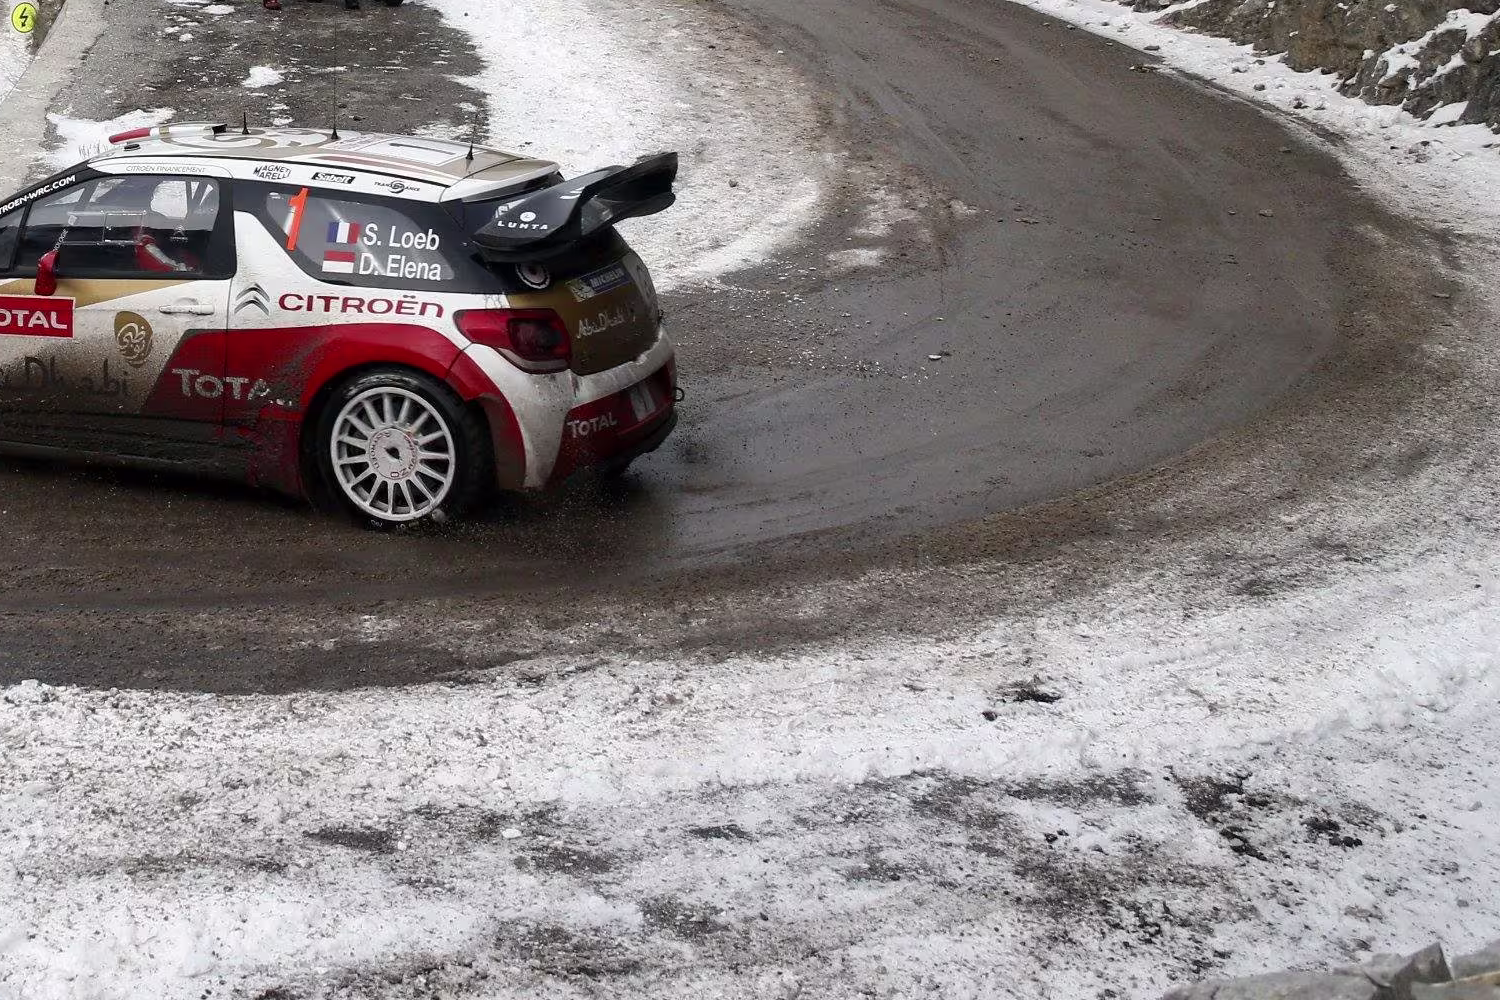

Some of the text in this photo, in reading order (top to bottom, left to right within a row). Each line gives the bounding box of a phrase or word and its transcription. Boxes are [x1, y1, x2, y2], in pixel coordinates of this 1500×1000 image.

[156, 166, 207, 174] FINANCEMENT
[314, 172, 353, 184] Sabelt
[286, 186, 309, 250] 1
[363, 223, 440, 250] S. Loeb
[359, 253, 442, 281] D. Elena
[278, 293, 444, 319] CITROËN
[567, 411, 618, 438] TOTAL
